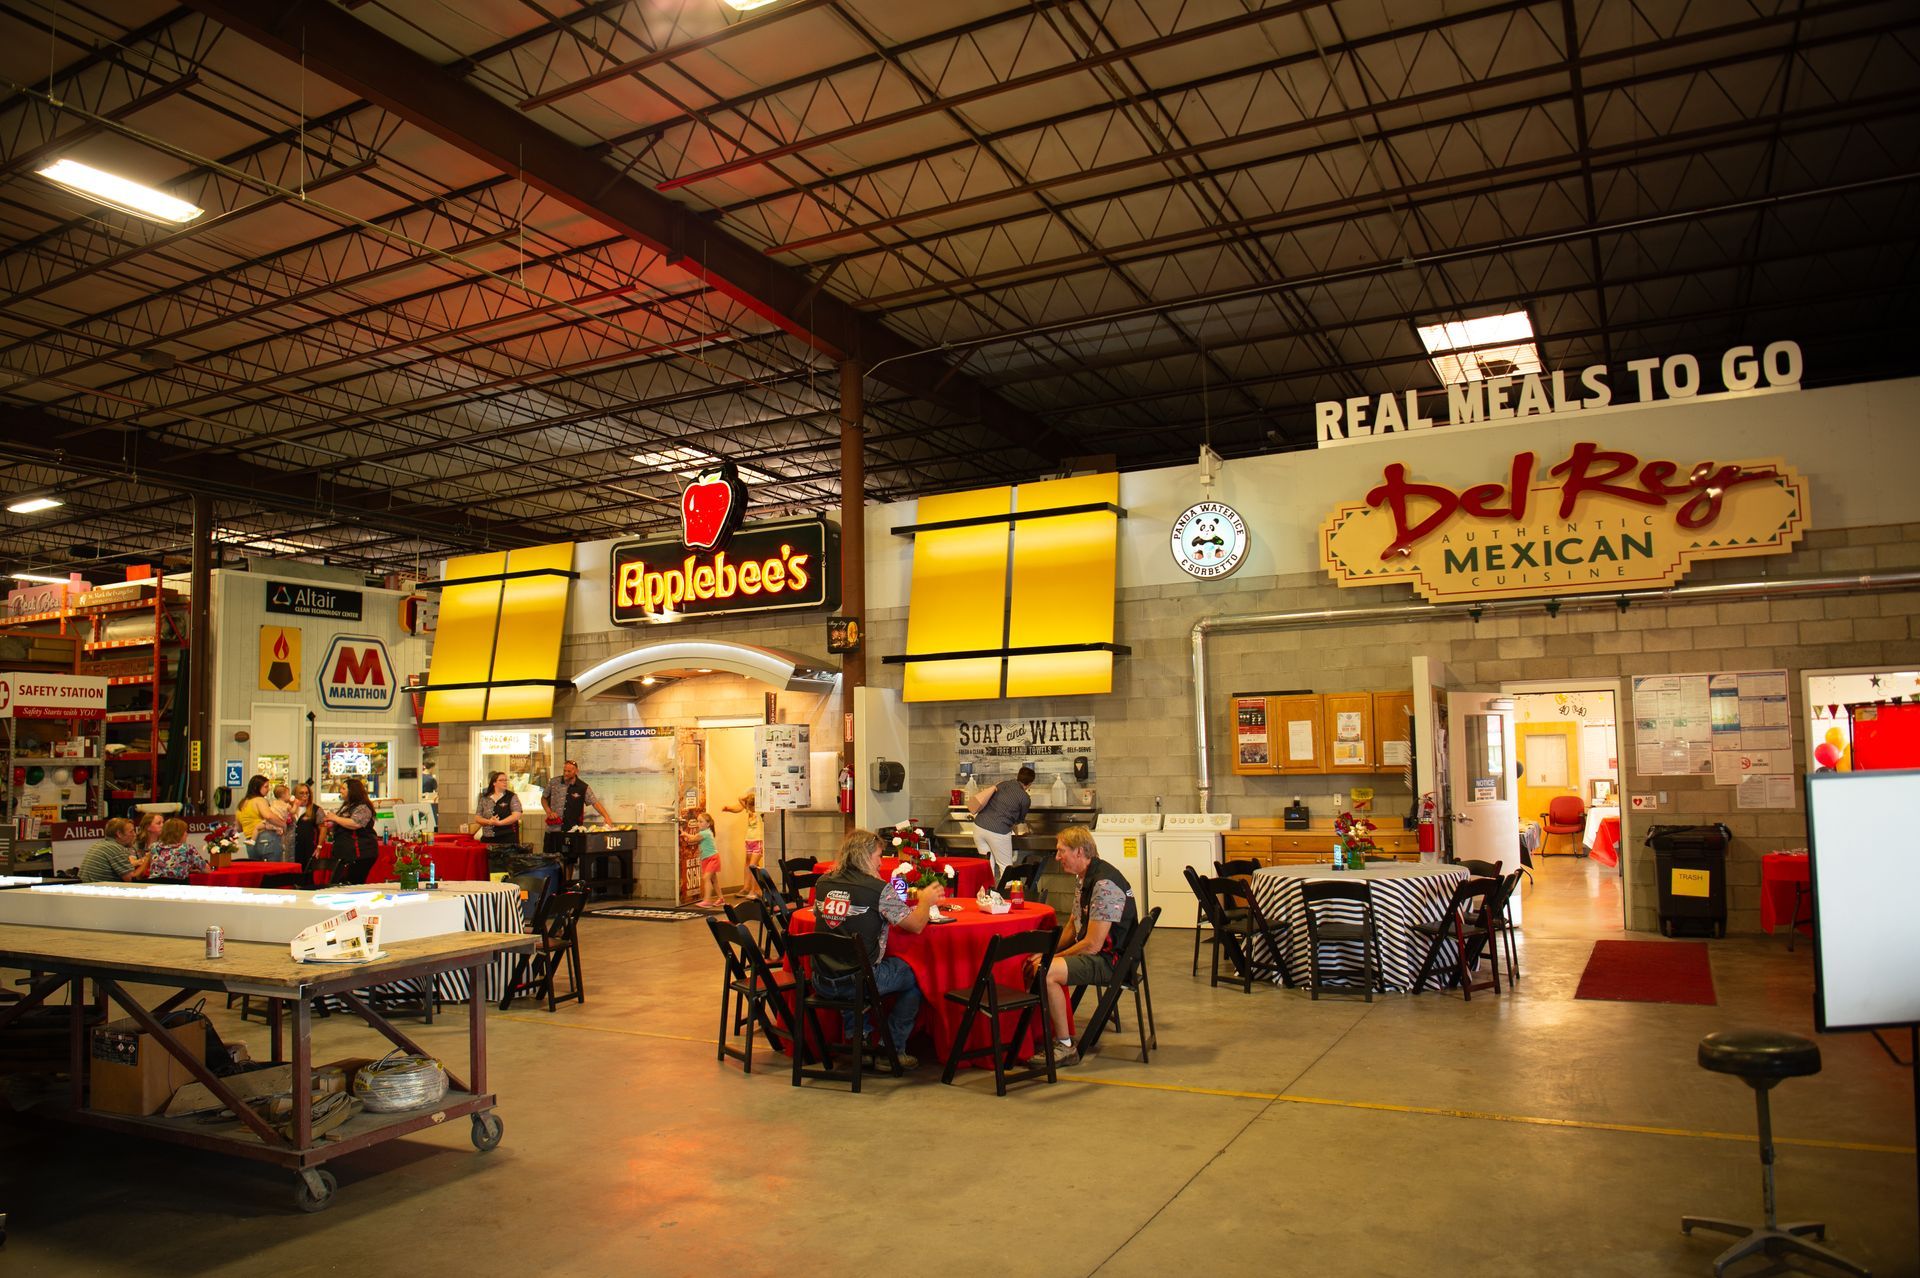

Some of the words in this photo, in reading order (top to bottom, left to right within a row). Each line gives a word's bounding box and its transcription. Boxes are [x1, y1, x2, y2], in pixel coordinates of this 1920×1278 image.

[1315, 389, 1433, 441] REAL
[1447, 364, 1612, 426] MEALS
[1627, 353, 1700, 402] TO
[1721, 340, 1803, 392] GO
[1366, 451, 1534, 561] Del
[1551, 442, 1780, 529] Rey
[1173, 509, 1198, 540] PANDA
[1199, 503, 1236, 520] WATER
[1233, 519, 1245, 536] ICE
[1442, 515, 1653, 544] AUTHENTIC
[1444, 531, 1654, 574] MEXICAN
[1188, 553, 1238, 576] SORBETTO
[617, 544, 809, 613] Applebee's
[1471, 566, 1625, 587] CUISINE
[295, 588, 336, 609] Altair
[311, 608, 341, 616] TECHNOLOGY
[19, 685, 58, 697] SAFETY
[60, 686, 104, 699] STATION
[329, 686, 387, 700] MARATHON
[23, 707, 42, 717] Safety
[44, 708, 62, 716] Starts
[590, 730, 628, 738] SCHEDULE
[959, 722, 1003, 746] SOAP
[1006, 723, 1027, 742] and
[1029, 719, 1091, 745] WATER
[64, 826, 105, 839] Allian
[606, 836, 621, 850] Lite
[1679, 873, 1703, 881] TRASH
[825, 900, 847, 916] 40
